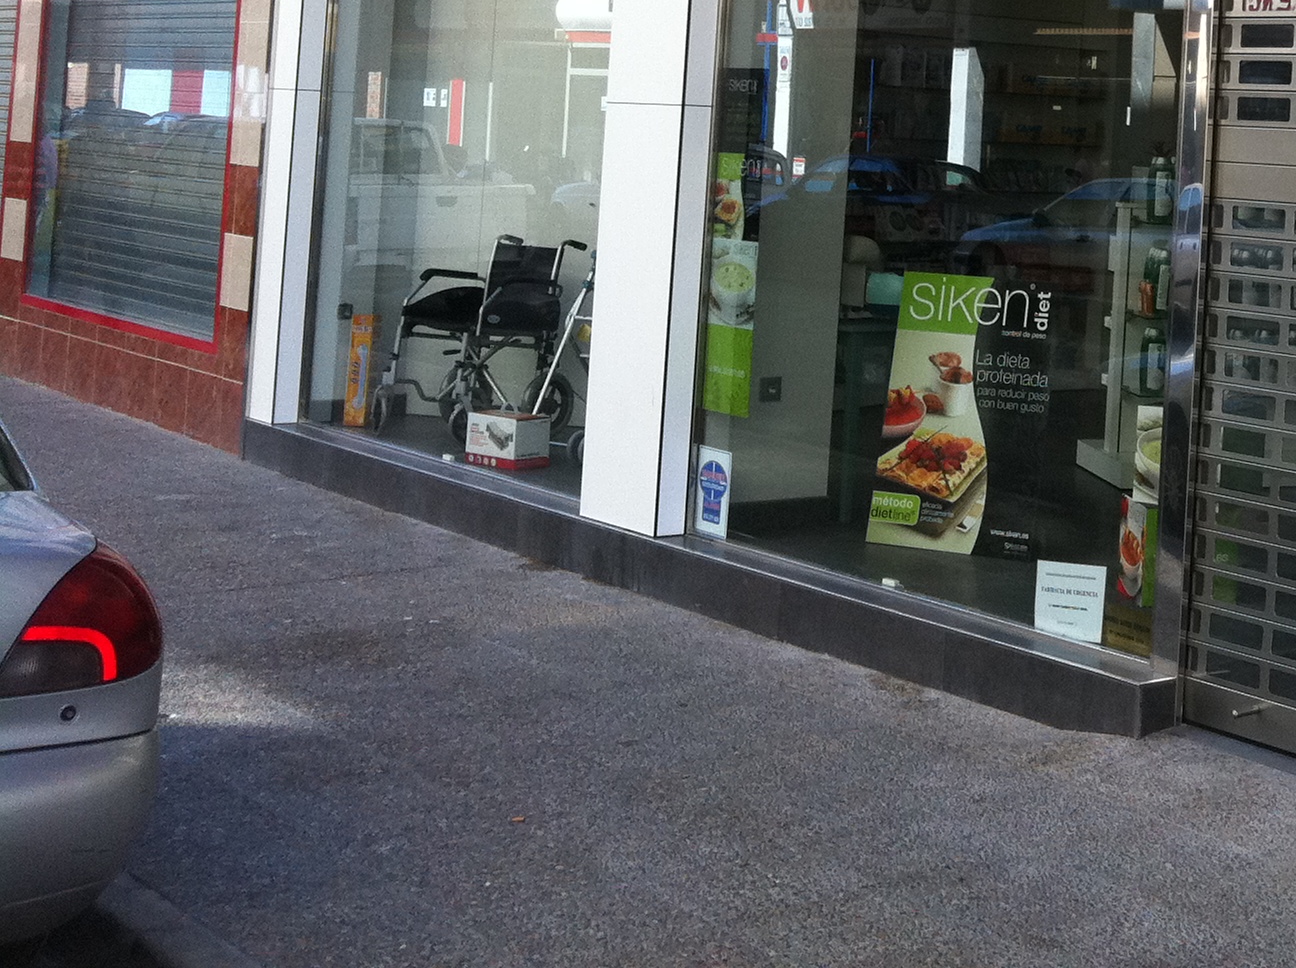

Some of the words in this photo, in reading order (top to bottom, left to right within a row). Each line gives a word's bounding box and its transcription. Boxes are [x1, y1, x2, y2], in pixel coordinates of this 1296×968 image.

[908, 277, 1030, 328] siken
[1034, 291, 1051, 332] diet
[975, 349, 993, 366] La
[996, 351, 1031, 369] dieta
[976, 368, 1049, 388] proteinada
[976, 387, 996, 397] para
[997, 388, 1026, 399] reducir
[1027, 392, 1050, 402] peso
[978, 400, 996, 409] con
[996, 399, 1019, 411] buen
[1020, 403, 1045, 414] gusto
[872, 495, 914, 509] método
